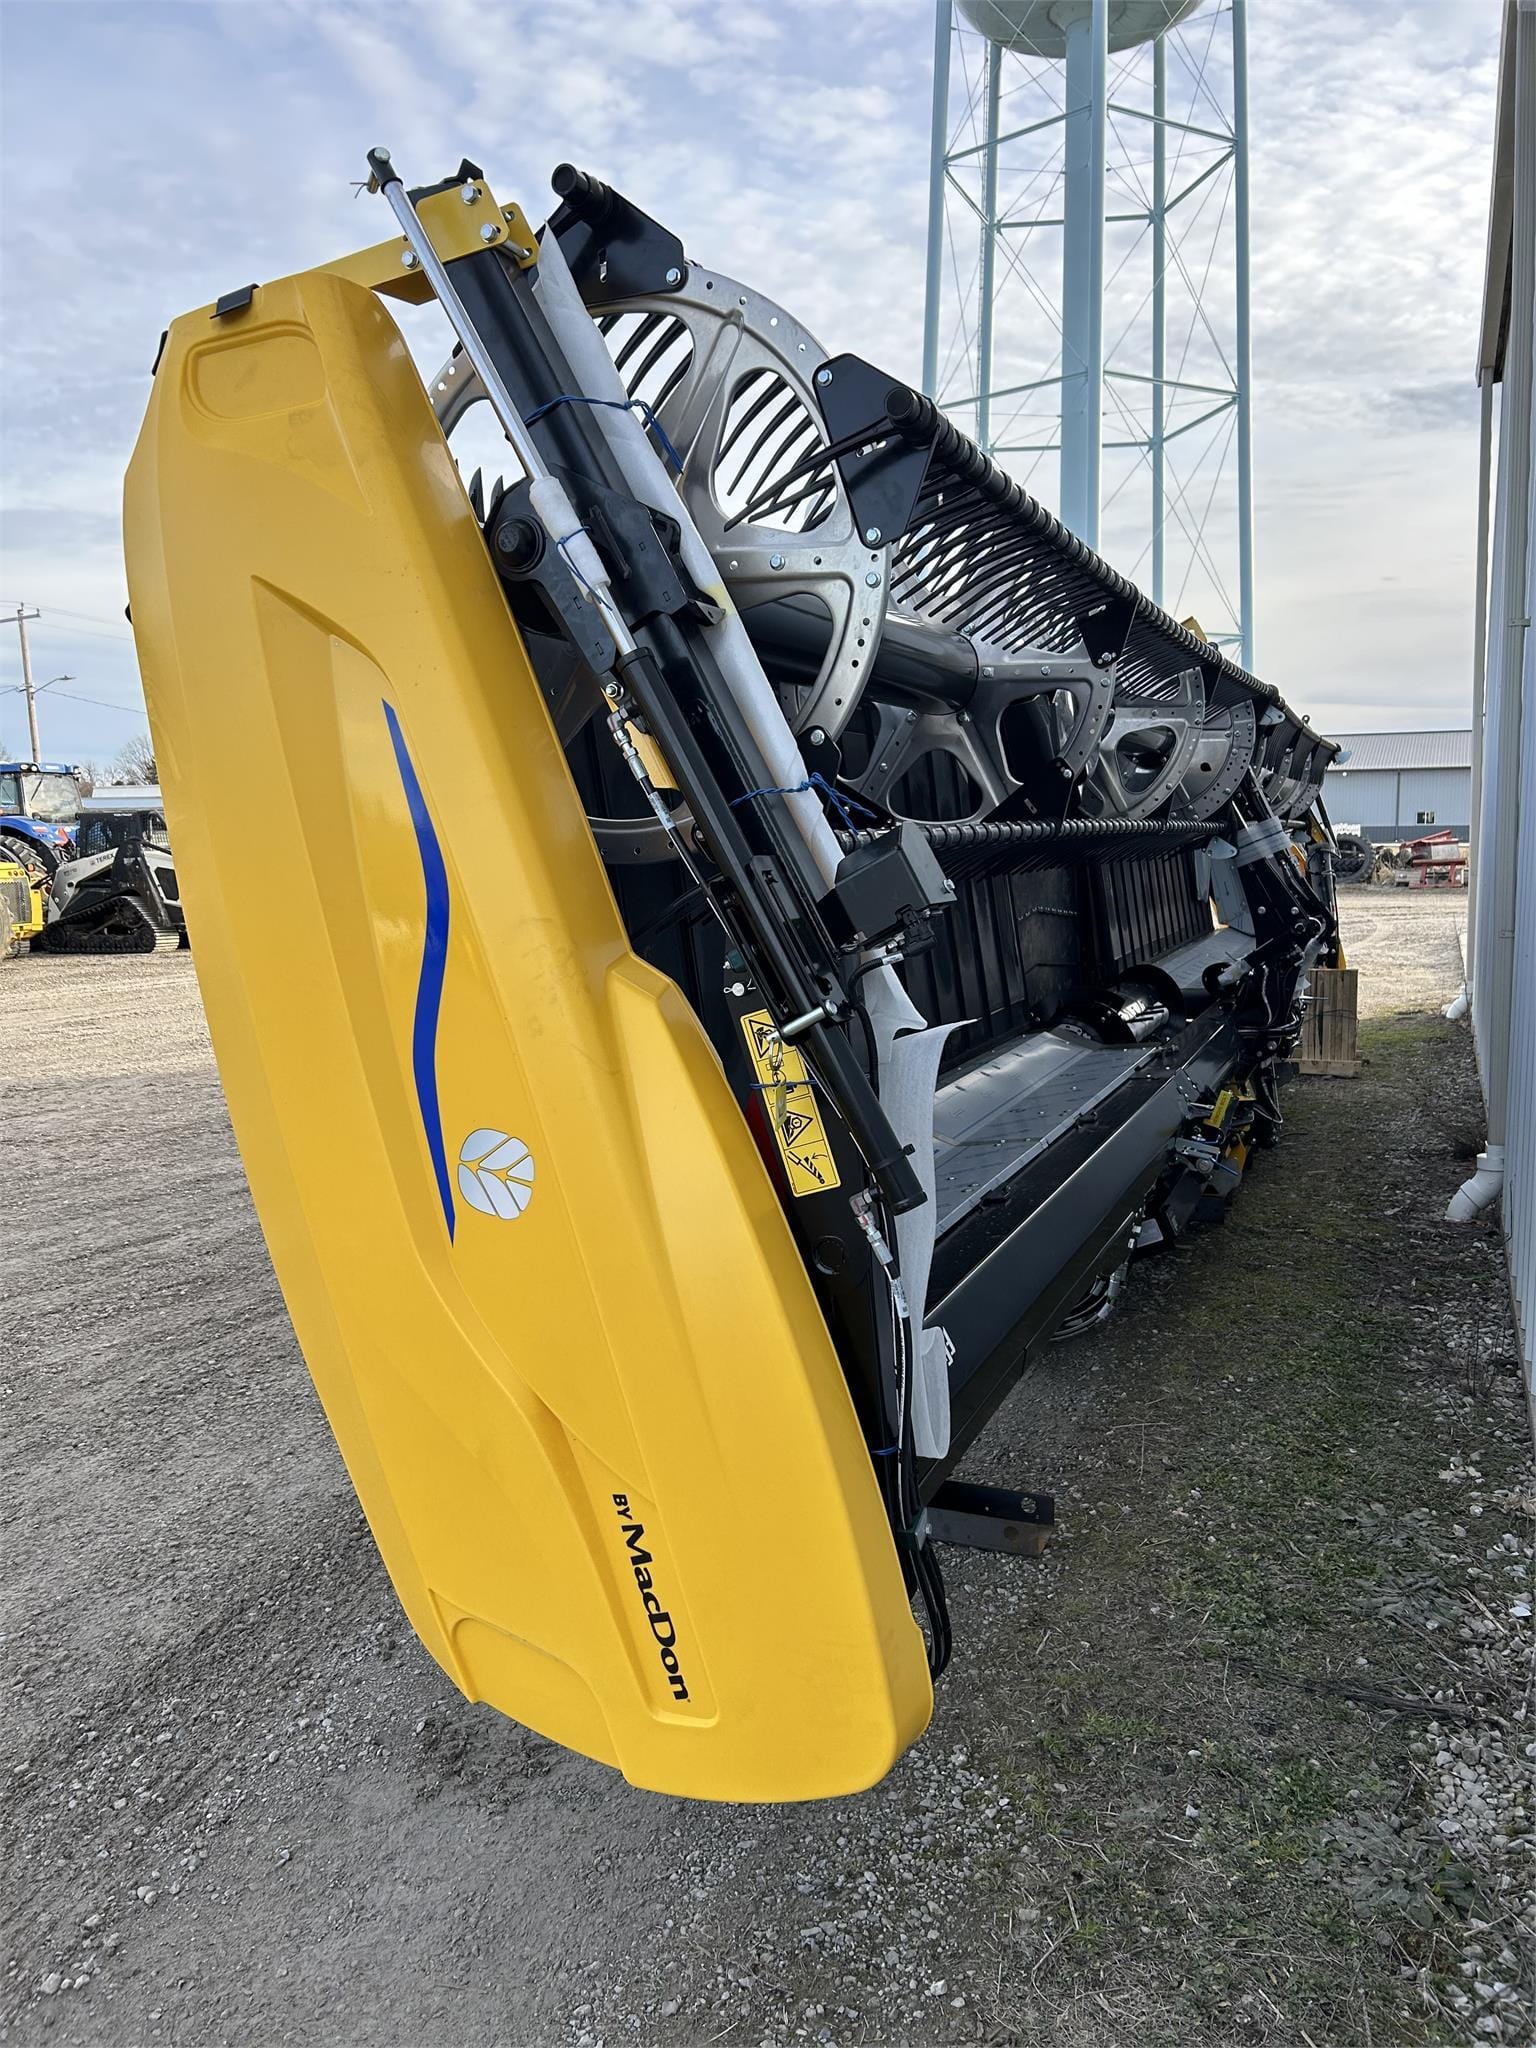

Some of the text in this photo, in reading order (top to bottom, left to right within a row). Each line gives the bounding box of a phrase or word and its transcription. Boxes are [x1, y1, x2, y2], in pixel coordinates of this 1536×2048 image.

[96, 853, 114, 863] TEREX
[612, 1493, 690, 1701] BY MacDon
